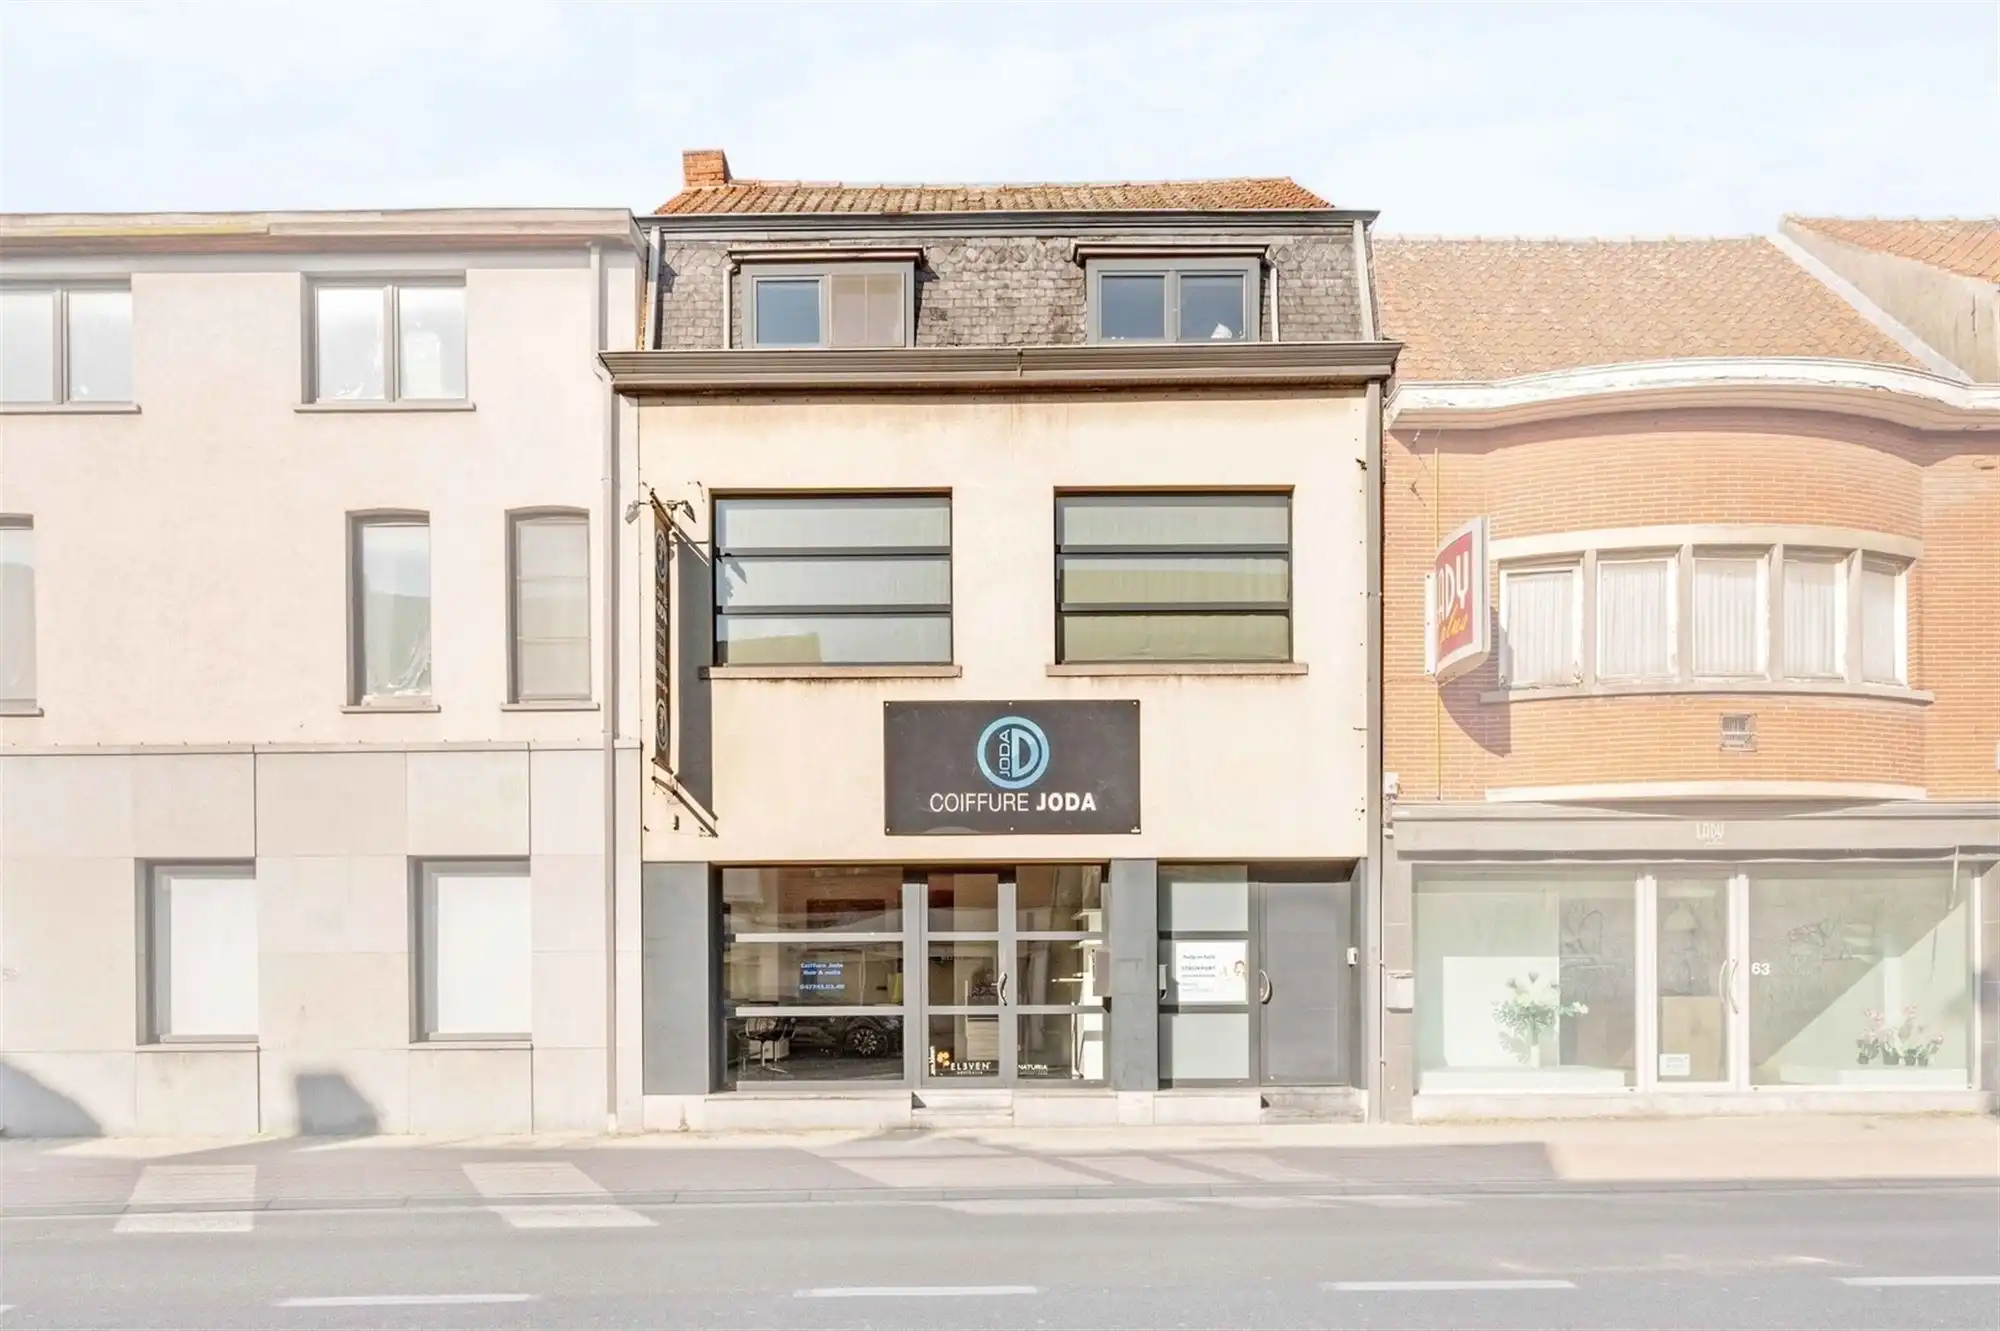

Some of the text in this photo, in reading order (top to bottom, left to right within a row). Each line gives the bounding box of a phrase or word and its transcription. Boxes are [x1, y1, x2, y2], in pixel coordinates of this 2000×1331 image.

[1437, 550, 1470, 621] ADY
[998, 729, 1010, 777] JODA
[929, 792, 1097, 812] COIFFURE JODA
[1696, 822, 1724, 841] LADY
[1751, 962, 1770, 975] 63
